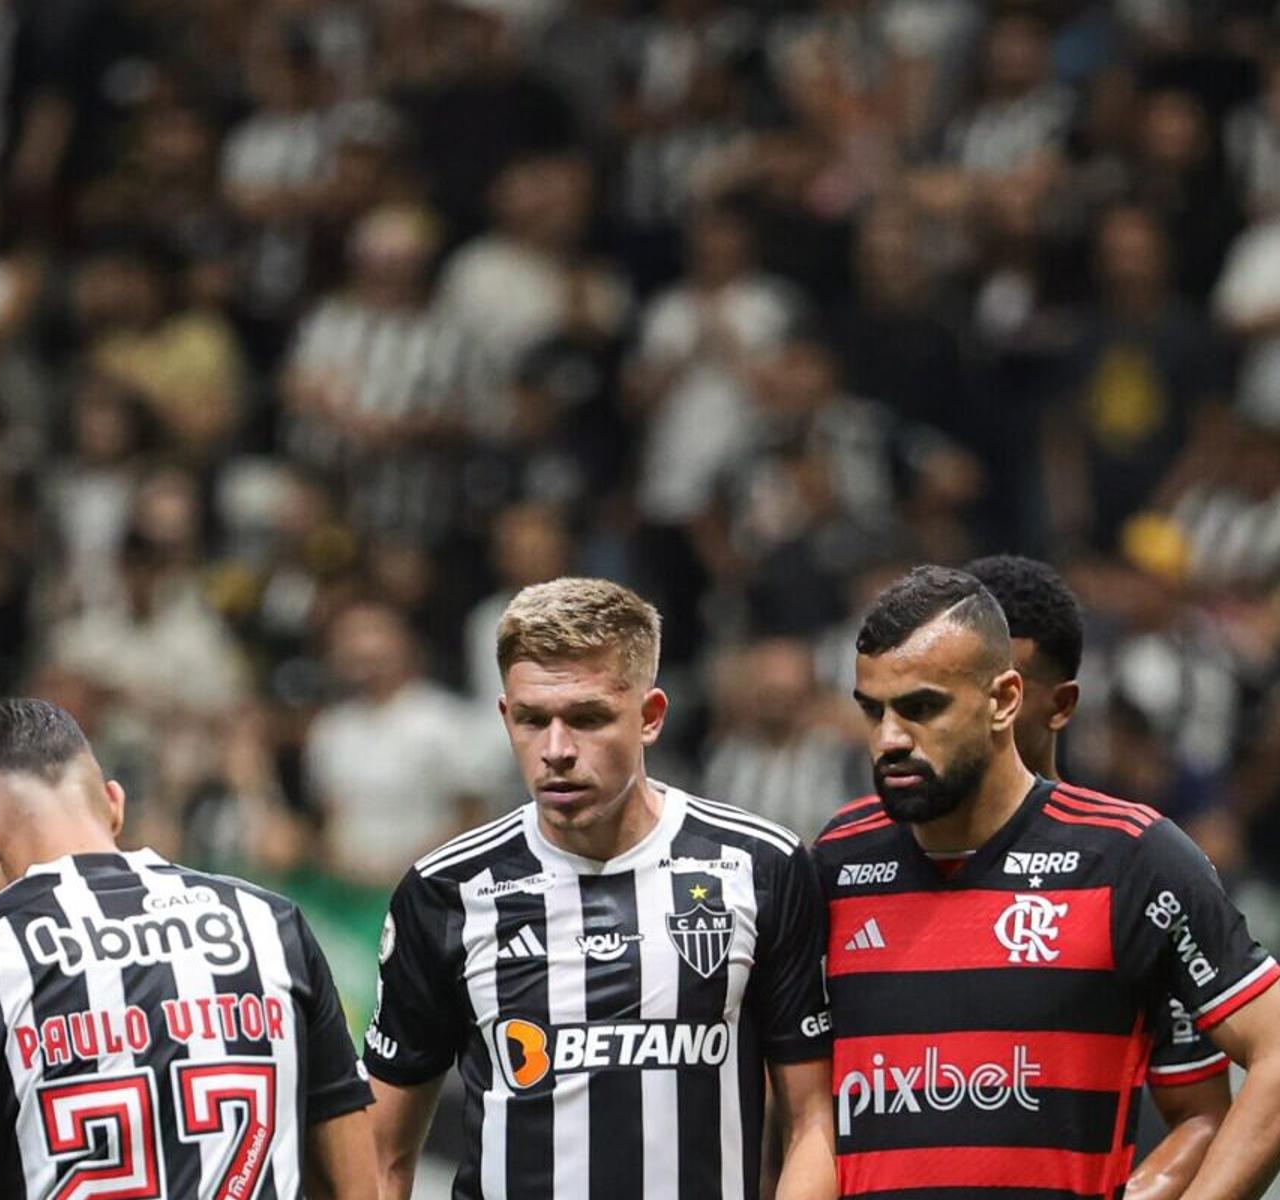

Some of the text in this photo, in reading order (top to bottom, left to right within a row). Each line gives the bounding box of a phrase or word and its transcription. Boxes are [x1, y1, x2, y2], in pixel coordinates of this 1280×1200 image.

[858, 860, 899, 885] BRB
[1030, 851, 1081, 874] BRB
[81, 911, 242, 967] bmg
[677, 916, 727, 930] CAM
[15, 993, 285, 1070] PAULO VITOR
[553, 1022, 730, 1070] BETANO
[837, 1044, 1041, 1137] pixbet
